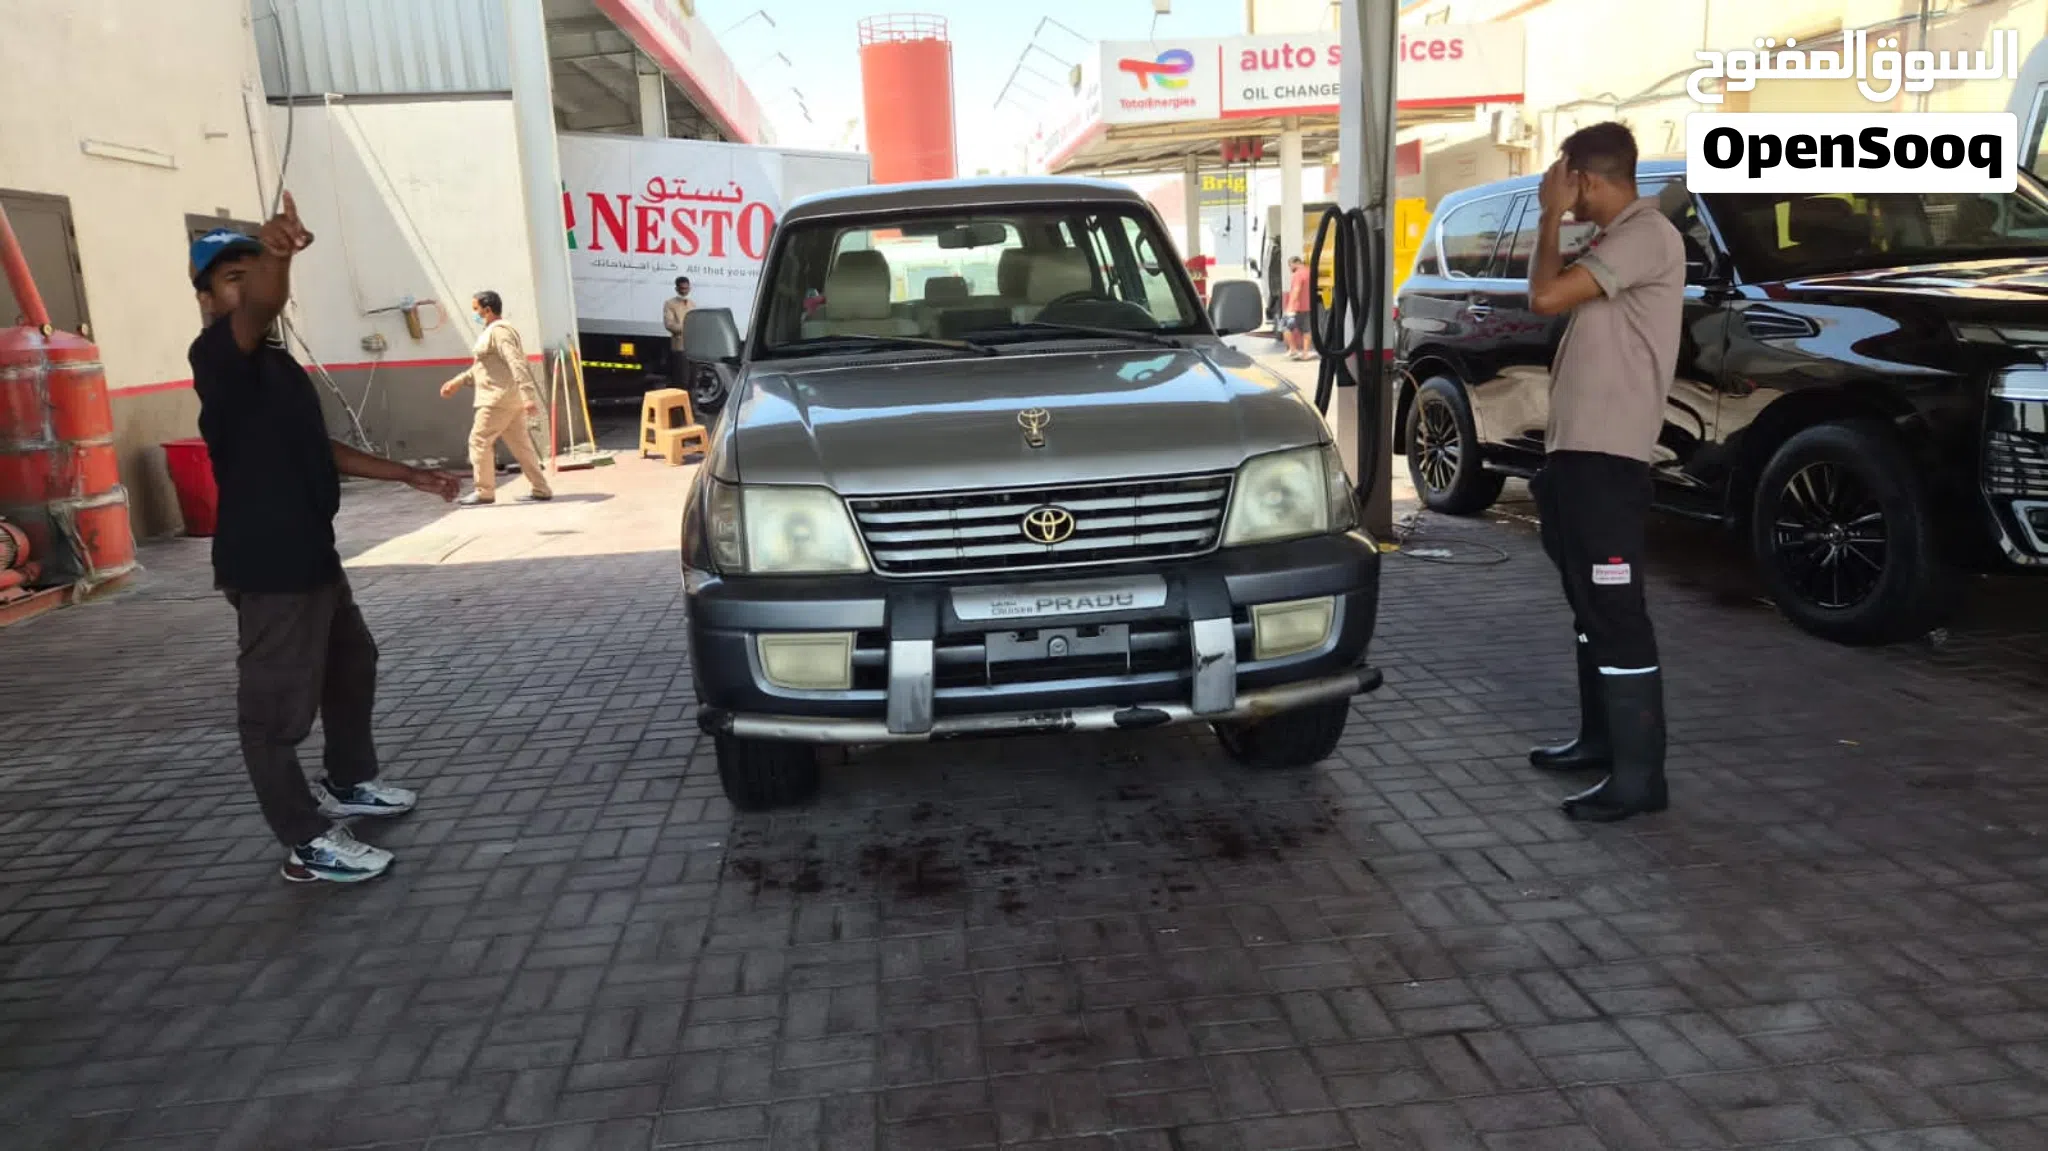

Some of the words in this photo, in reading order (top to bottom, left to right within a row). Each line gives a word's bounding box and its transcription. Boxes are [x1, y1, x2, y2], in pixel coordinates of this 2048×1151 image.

[1240, 43, 1316, 71] auto
[1327, 34, 1464, 66] sices
[1243, 88, 1268, 100] OIL
[1274, 83, 1340, 98] CHANGE
[1119, 96, 1197, 110] TotalEnergies
[640, 176, 743, 203] نستو
[586, 192, 777, 260] NESTO
[703, 265, 725, 275] that
